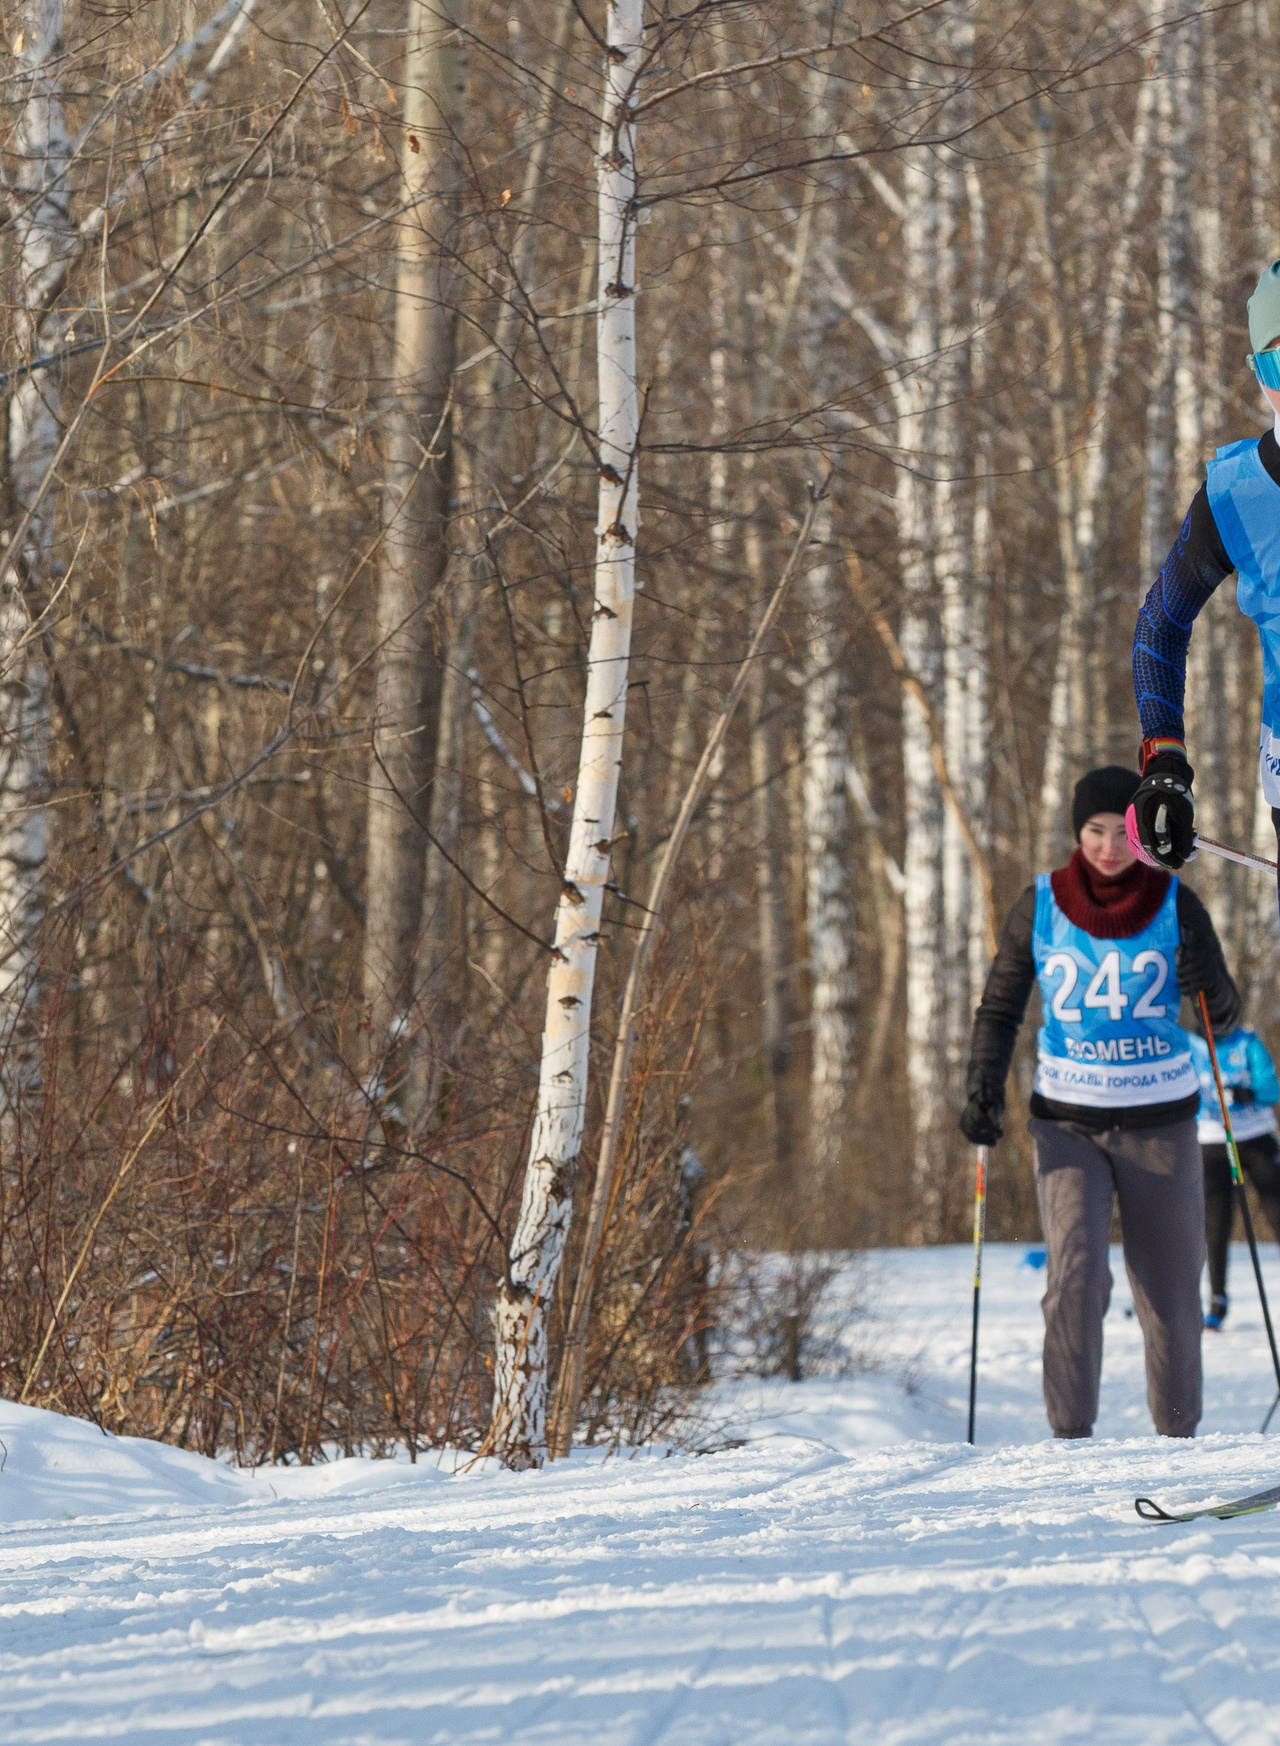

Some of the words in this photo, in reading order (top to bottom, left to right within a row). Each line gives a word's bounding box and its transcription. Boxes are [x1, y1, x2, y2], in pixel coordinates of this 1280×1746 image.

[1043, 949, 1169, 1022] 242
[1063, 1034, 1172, 1061] ТЮМЕНЬ
[1107, 1074, 1158, 1088] ГОРОДА
